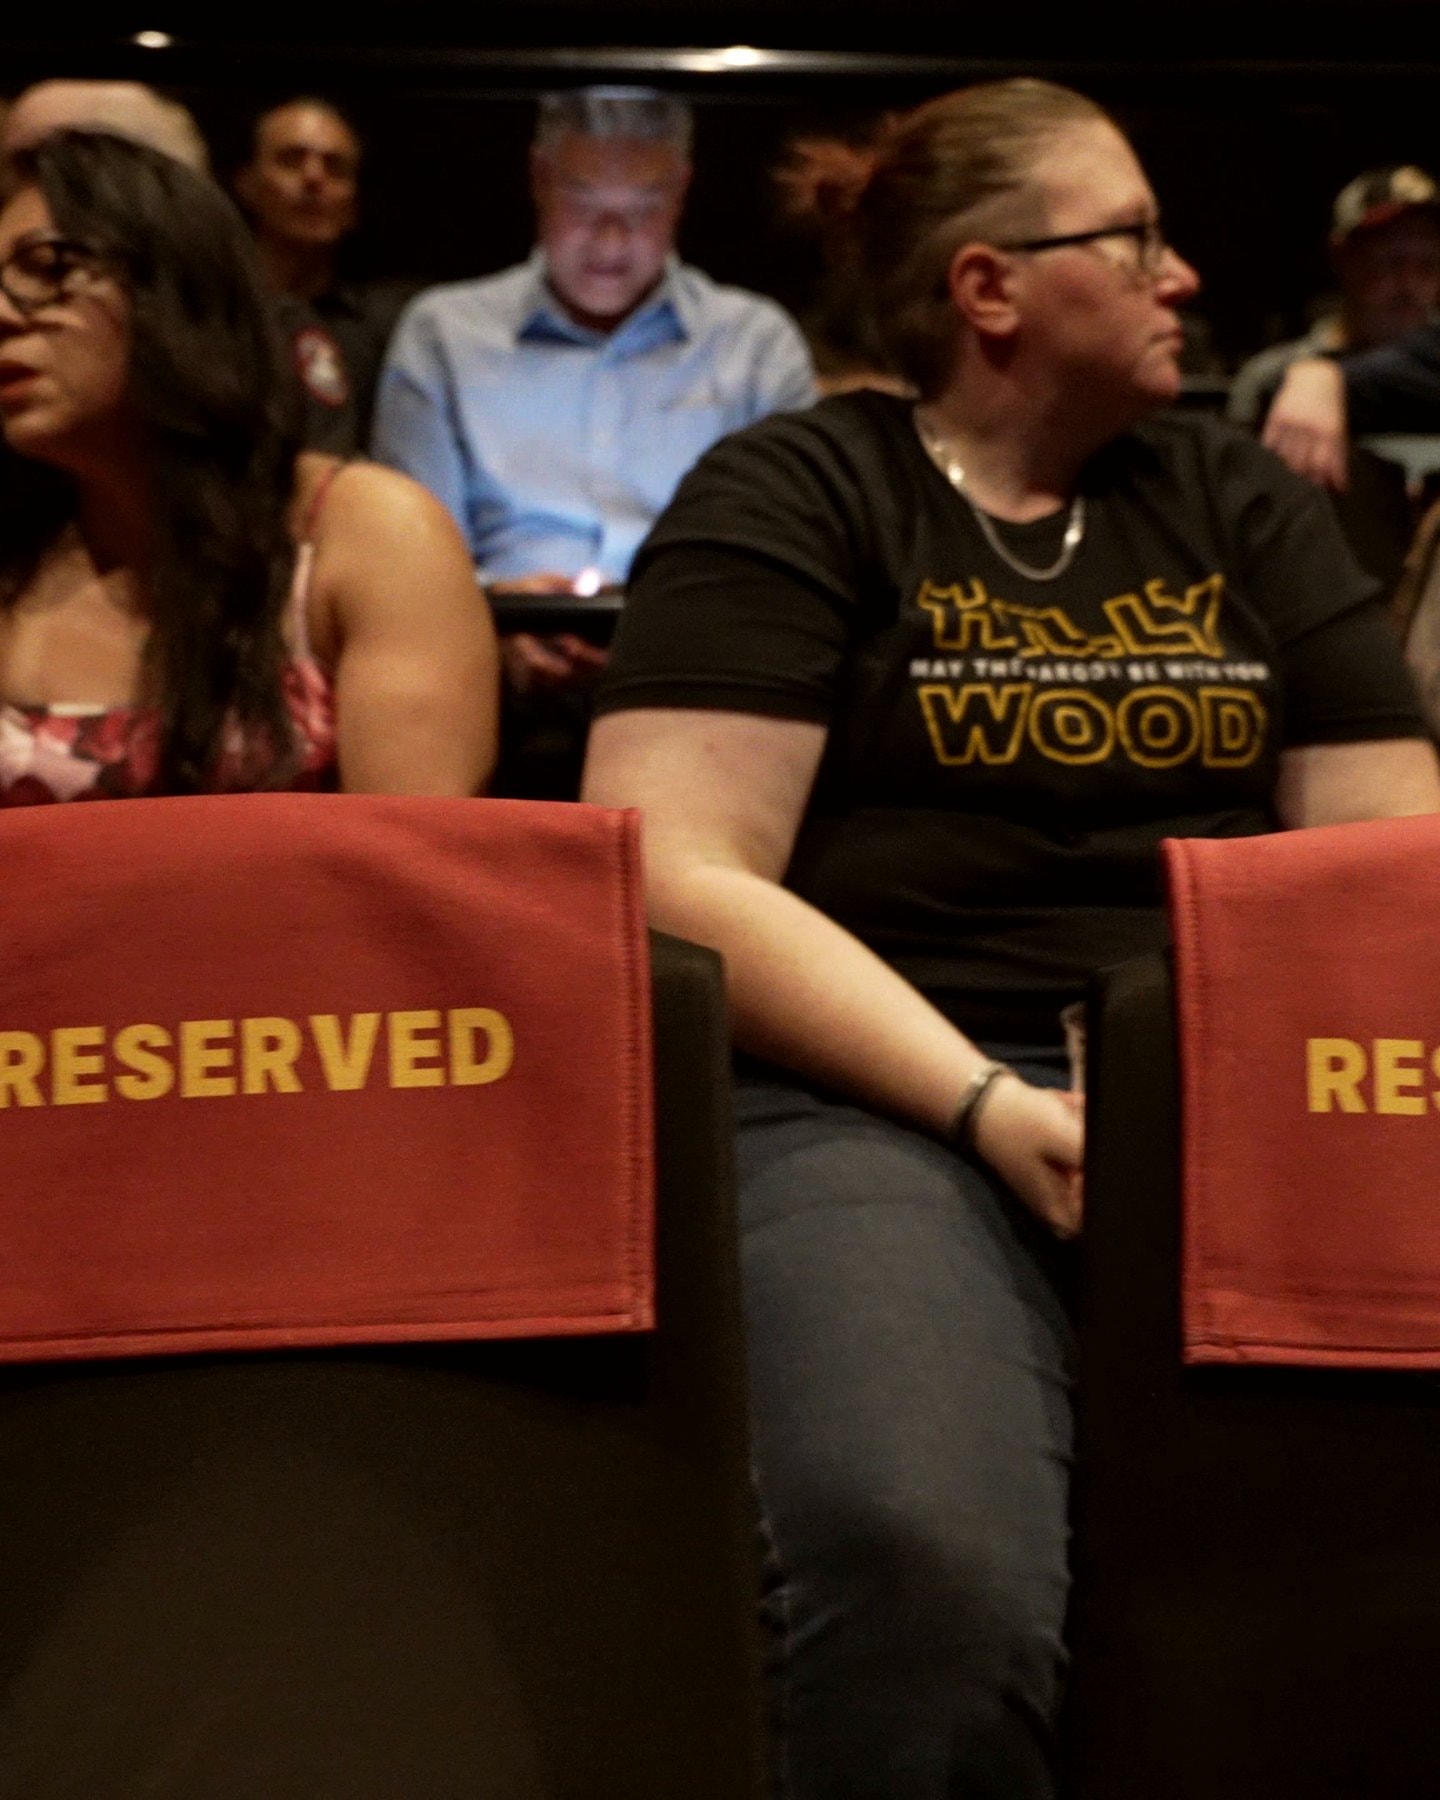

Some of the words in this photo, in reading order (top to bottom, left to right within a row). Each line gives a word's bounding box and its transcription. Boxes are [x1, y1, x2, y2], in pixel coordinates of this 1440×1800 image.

[909, 657, 964, 678] MAY
[917, 682, 1267, 769] WOOD
[0, 1007, 515, 1108] RESERVED
[1305, 1037, 1440, 1116] RE
